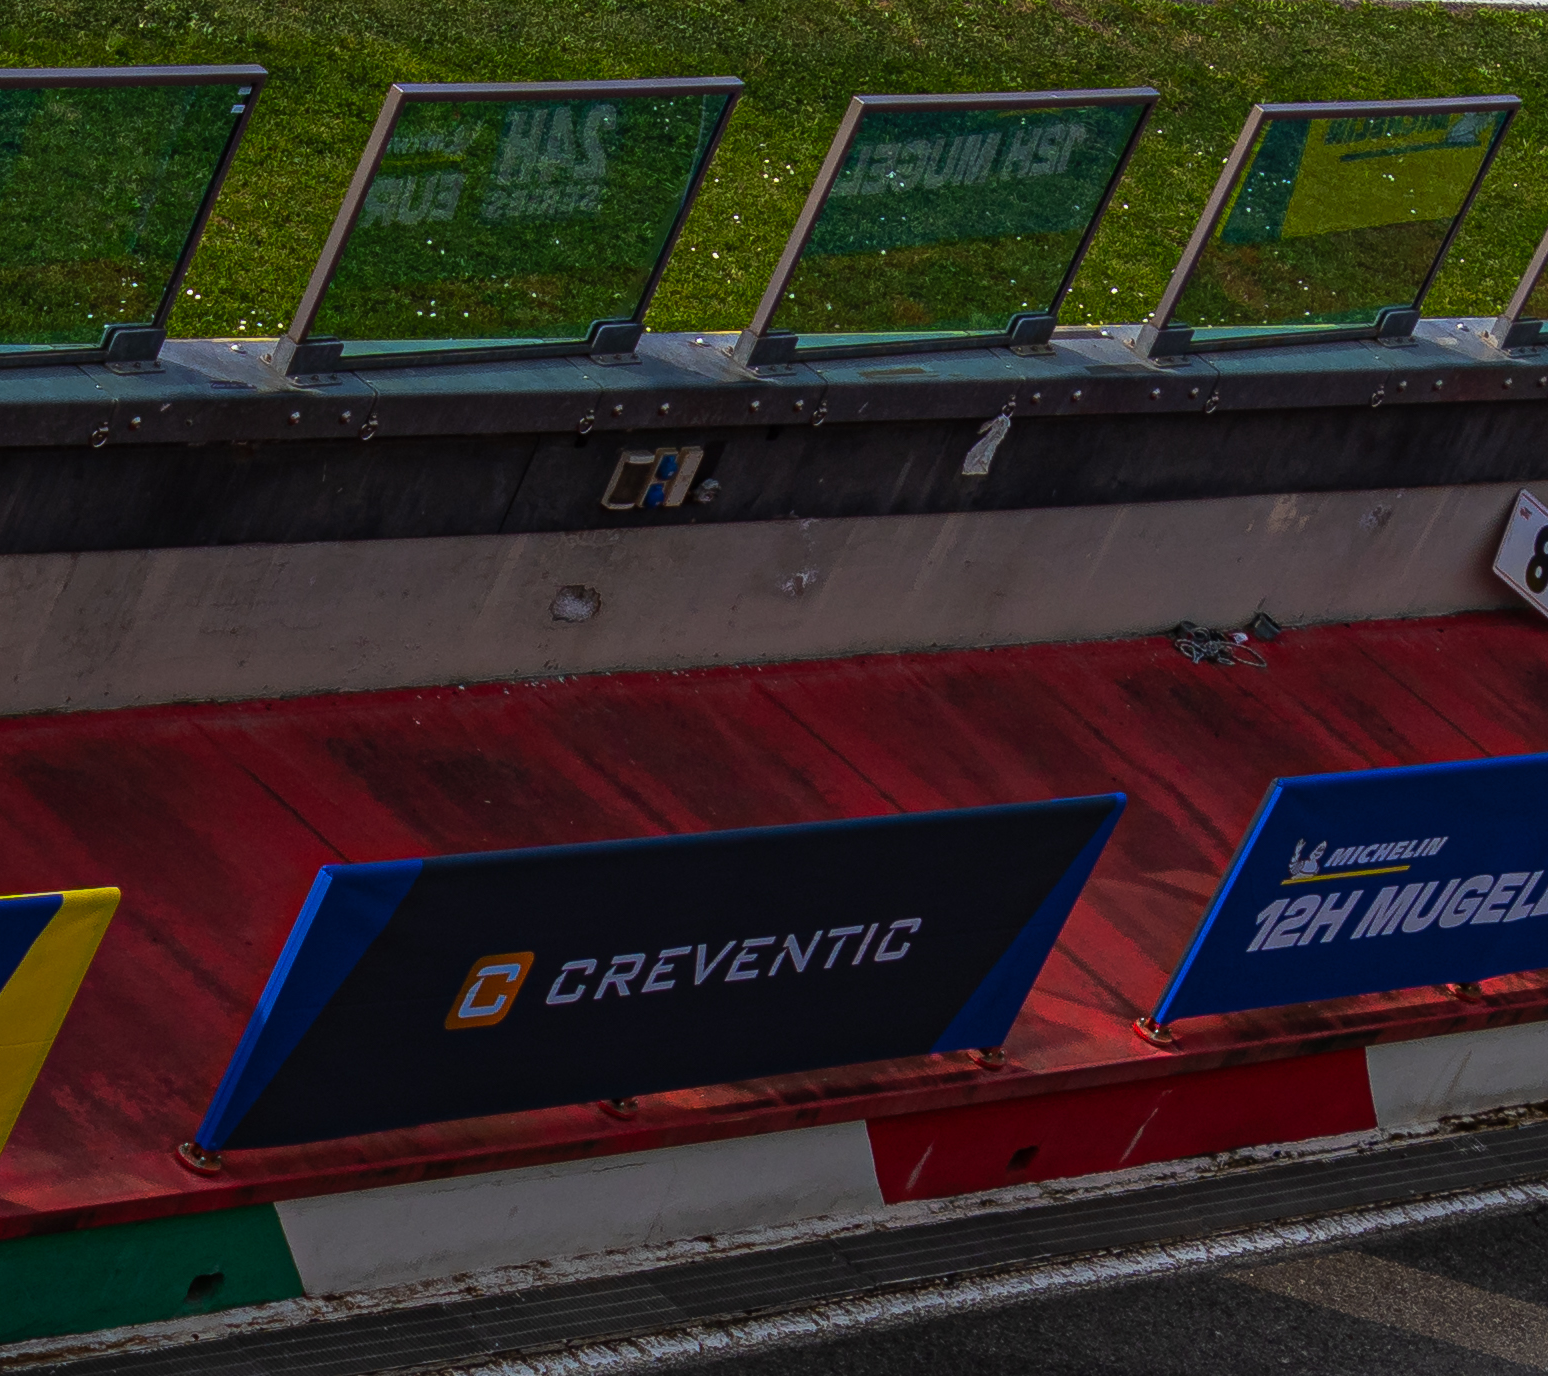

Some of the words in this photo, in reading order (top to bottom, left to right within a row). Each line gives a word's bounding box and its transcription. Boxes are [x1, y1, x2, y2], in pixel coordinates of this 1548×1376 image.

[1324, 836, 1449, 868] MICHELIN
[1246, 890, 1364, 953] 12H
[545, 917, 923, 1006] CREVENTIC
